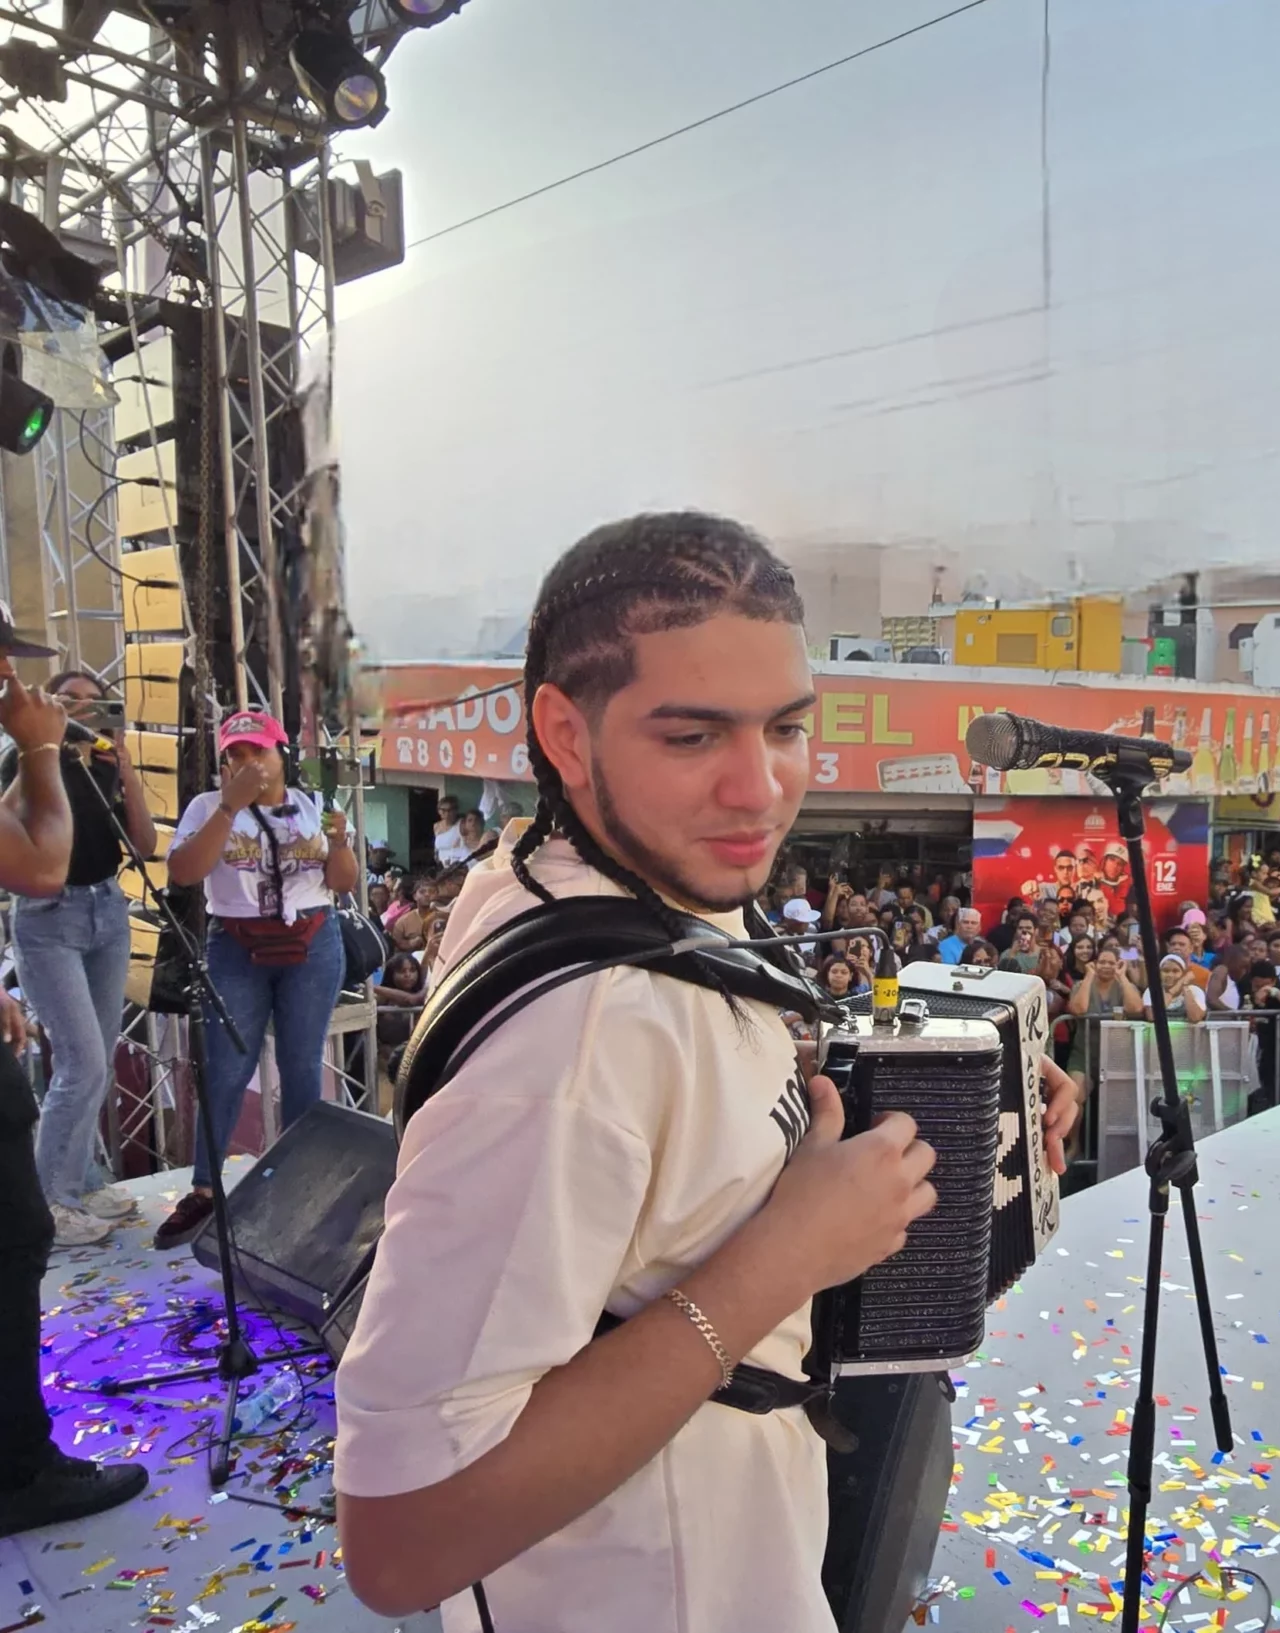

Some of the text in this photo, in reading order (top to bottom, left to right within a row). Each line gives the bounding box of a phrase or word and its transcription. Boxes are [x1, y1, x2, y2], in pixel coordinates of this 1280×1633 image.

[396, 684, 522, 734] ADO
[803, 693, 913, 744] EL
[1155, 861, 1177, 882] 12
[1027, 1055, 1043, 1202] ACORDEON
